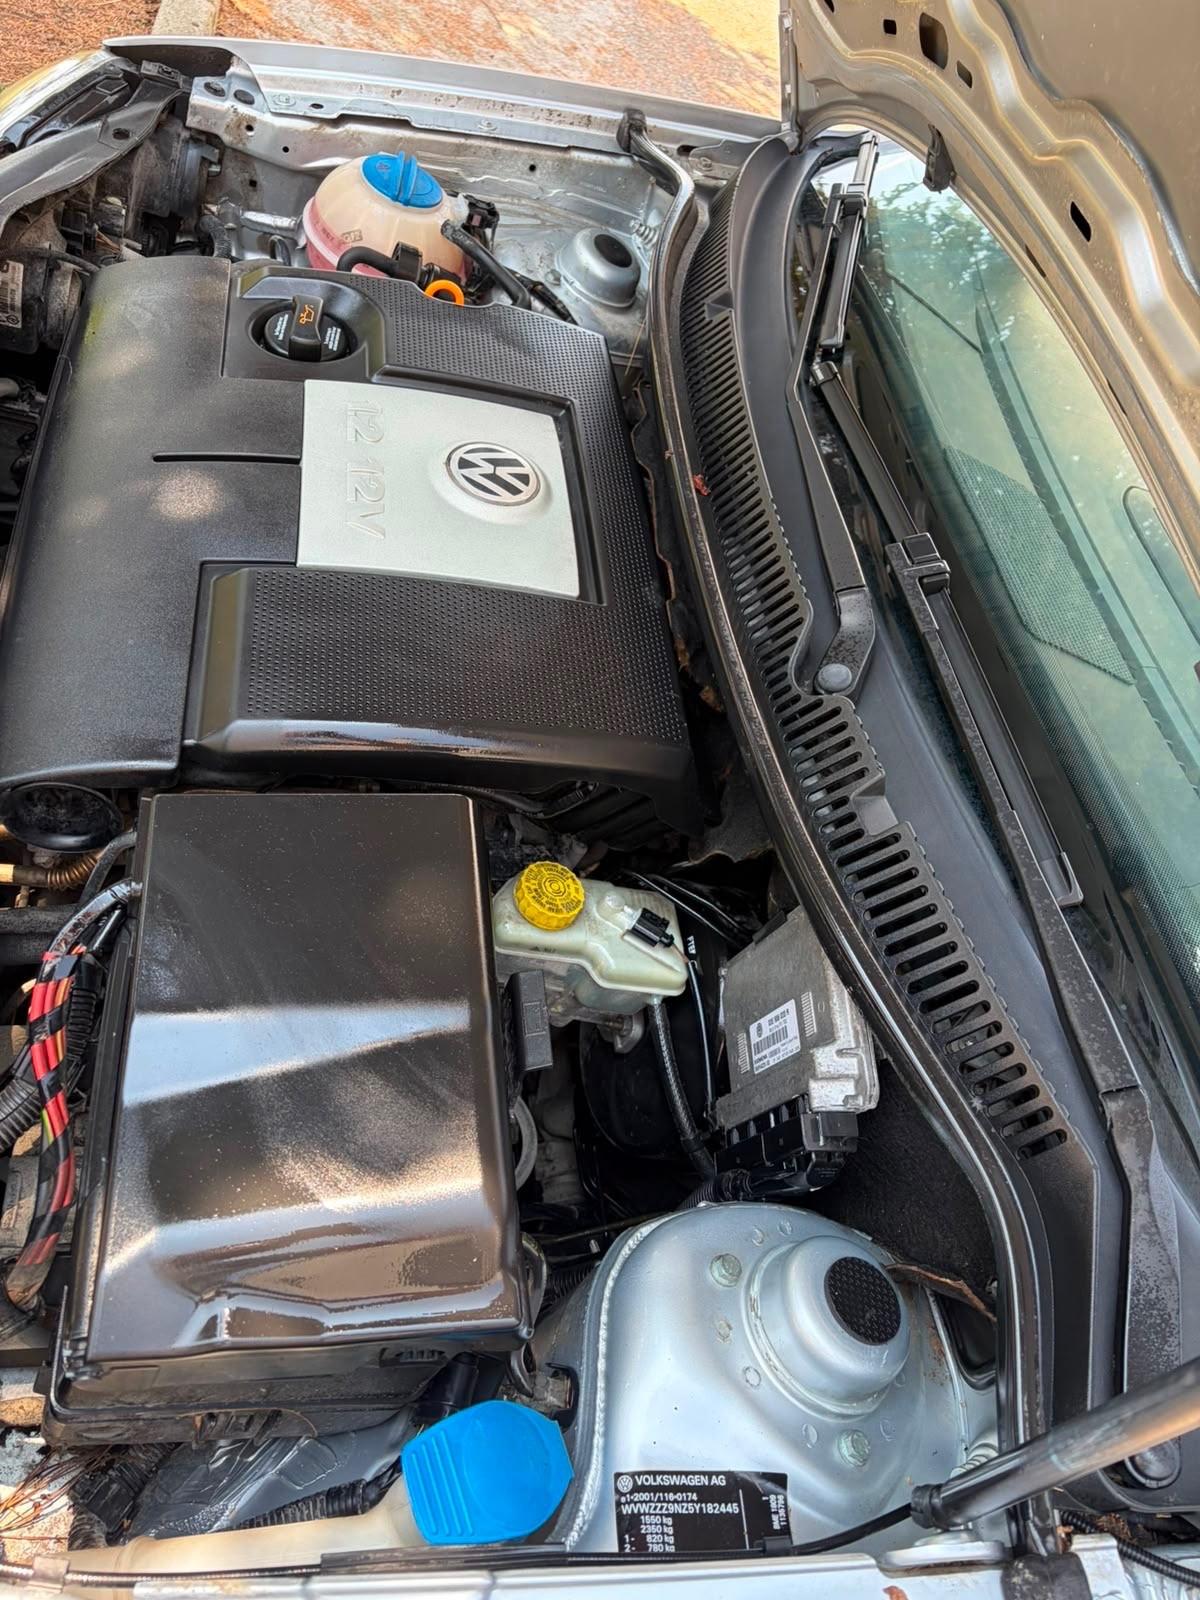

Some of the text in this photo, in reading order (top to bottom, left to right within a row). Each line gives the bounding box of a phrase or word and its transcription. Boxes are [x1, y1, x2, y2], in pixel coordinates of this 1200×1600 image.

[344, 457, 386, 539] 12V
[635, 1474, 708, 1486] VOLKSWAGEN
[710, 1474, 726, 1486] AG
[621, 1503, 739, 1514] WVWZZZ9NZ5Y182445
[640, 1515, 673, 1525] 1550 kg
[640, 1525, 674, 1535] 2350 kg
[646, 1534, 663, 1543] 820
[664, 1534, 675, 1544] kg
[647, 1543, 664, 1552] 780
[665, 1543, 675, 1552] kg
